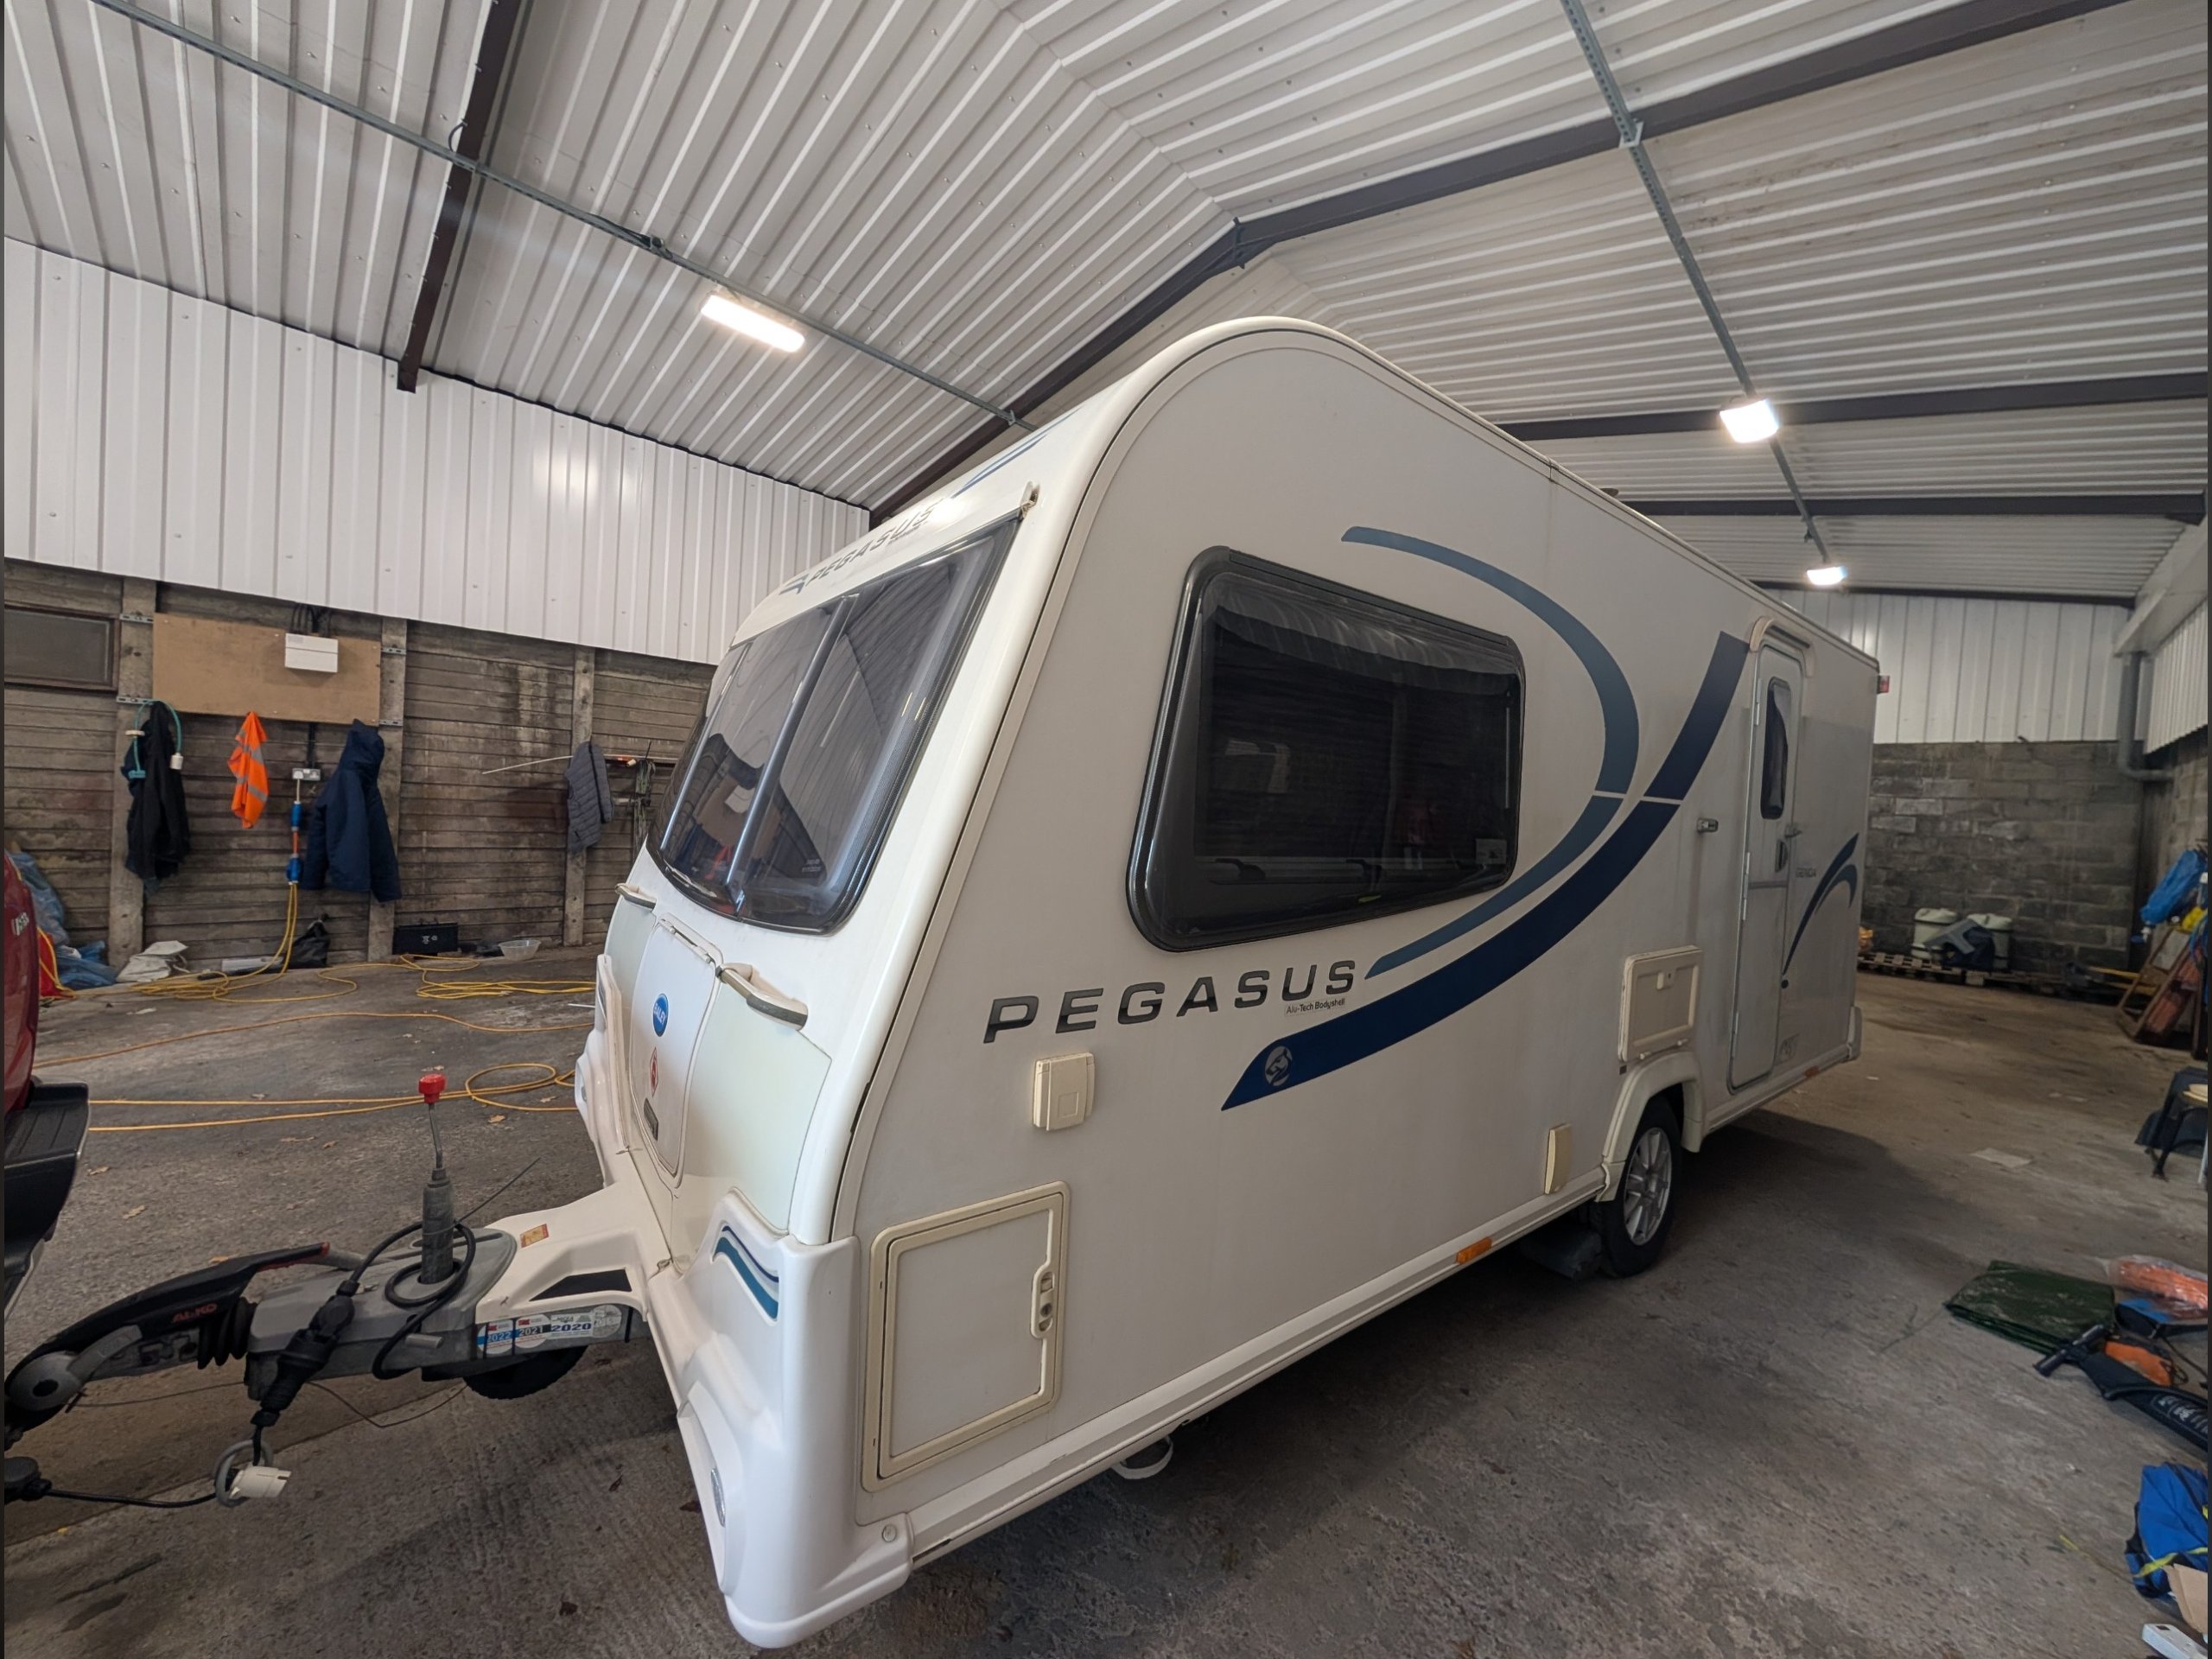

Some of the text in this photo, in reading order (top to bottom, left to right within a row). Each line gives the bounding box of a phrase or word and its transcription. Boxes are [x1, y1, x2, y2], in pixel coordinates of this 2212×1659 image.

[804, 498, 944, 587] PEGASUS
[982, 959, 1356, 1044] PEGASUS
[1286, 997, 1345, 1014] Alu-Tech Bodyshell
[518, 1325, 543, 1337] 2021
[551, 1322, 592, 1332] 2020
[487, 1332, 512, 1342] 2022
